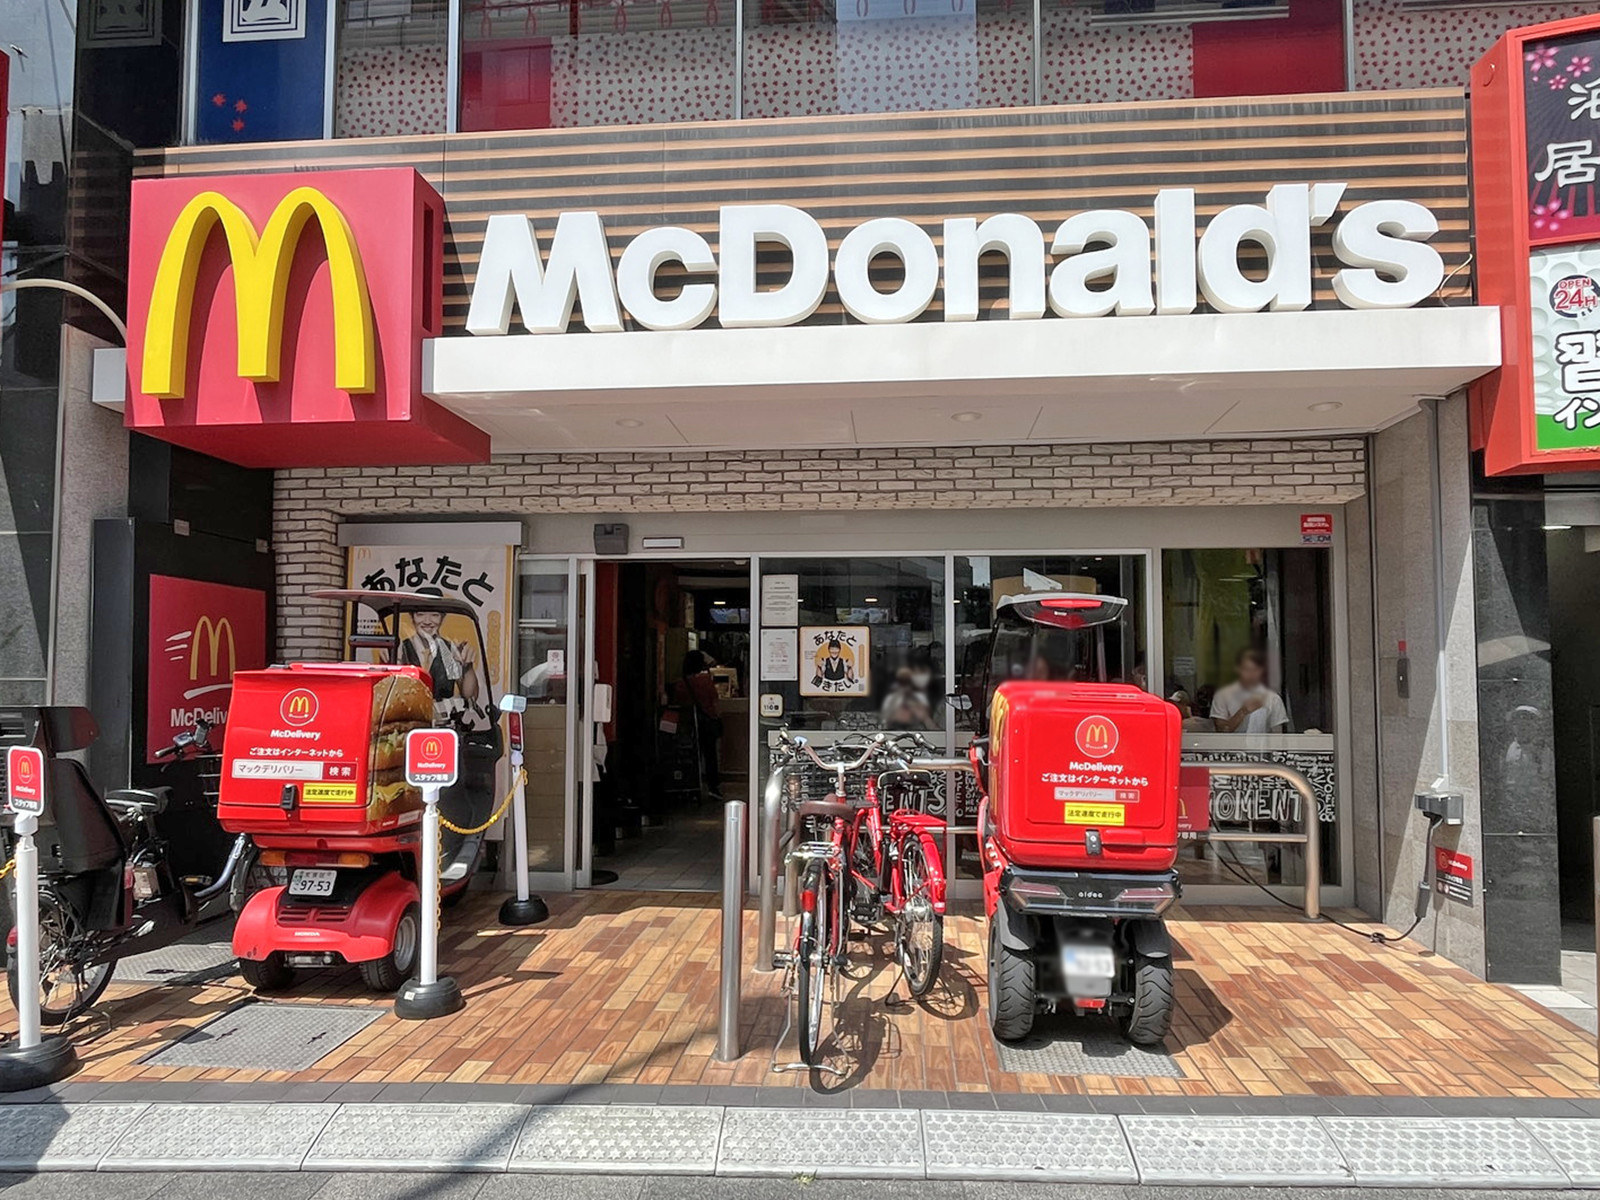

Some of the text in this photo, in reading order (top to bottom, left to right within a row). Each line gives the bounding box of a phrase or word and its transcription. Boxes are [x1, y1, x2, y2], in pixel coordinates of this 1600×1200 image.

[465, 182, 1445, 336] McDonald's
[1558, 277, 1593, 290] OPEN
[1555, 288, 1598, 311] 24H
[361, 555, 495, 607] あなたと
[813, 630, 857, 647] あなたと
[170, 707, 229, 727] McDeliv
[270, 729, 321, 741] McDelivery
[249, 747, 344, 758] ご注文はインターネットから
[238, 764, 304, 775] マックデリバリー
[1069, 761, 1123, 775] McDelivery
[1041, 773, 1149, 787] ご注文はインターネットから
[300, 880, 331, 891] 97-53
